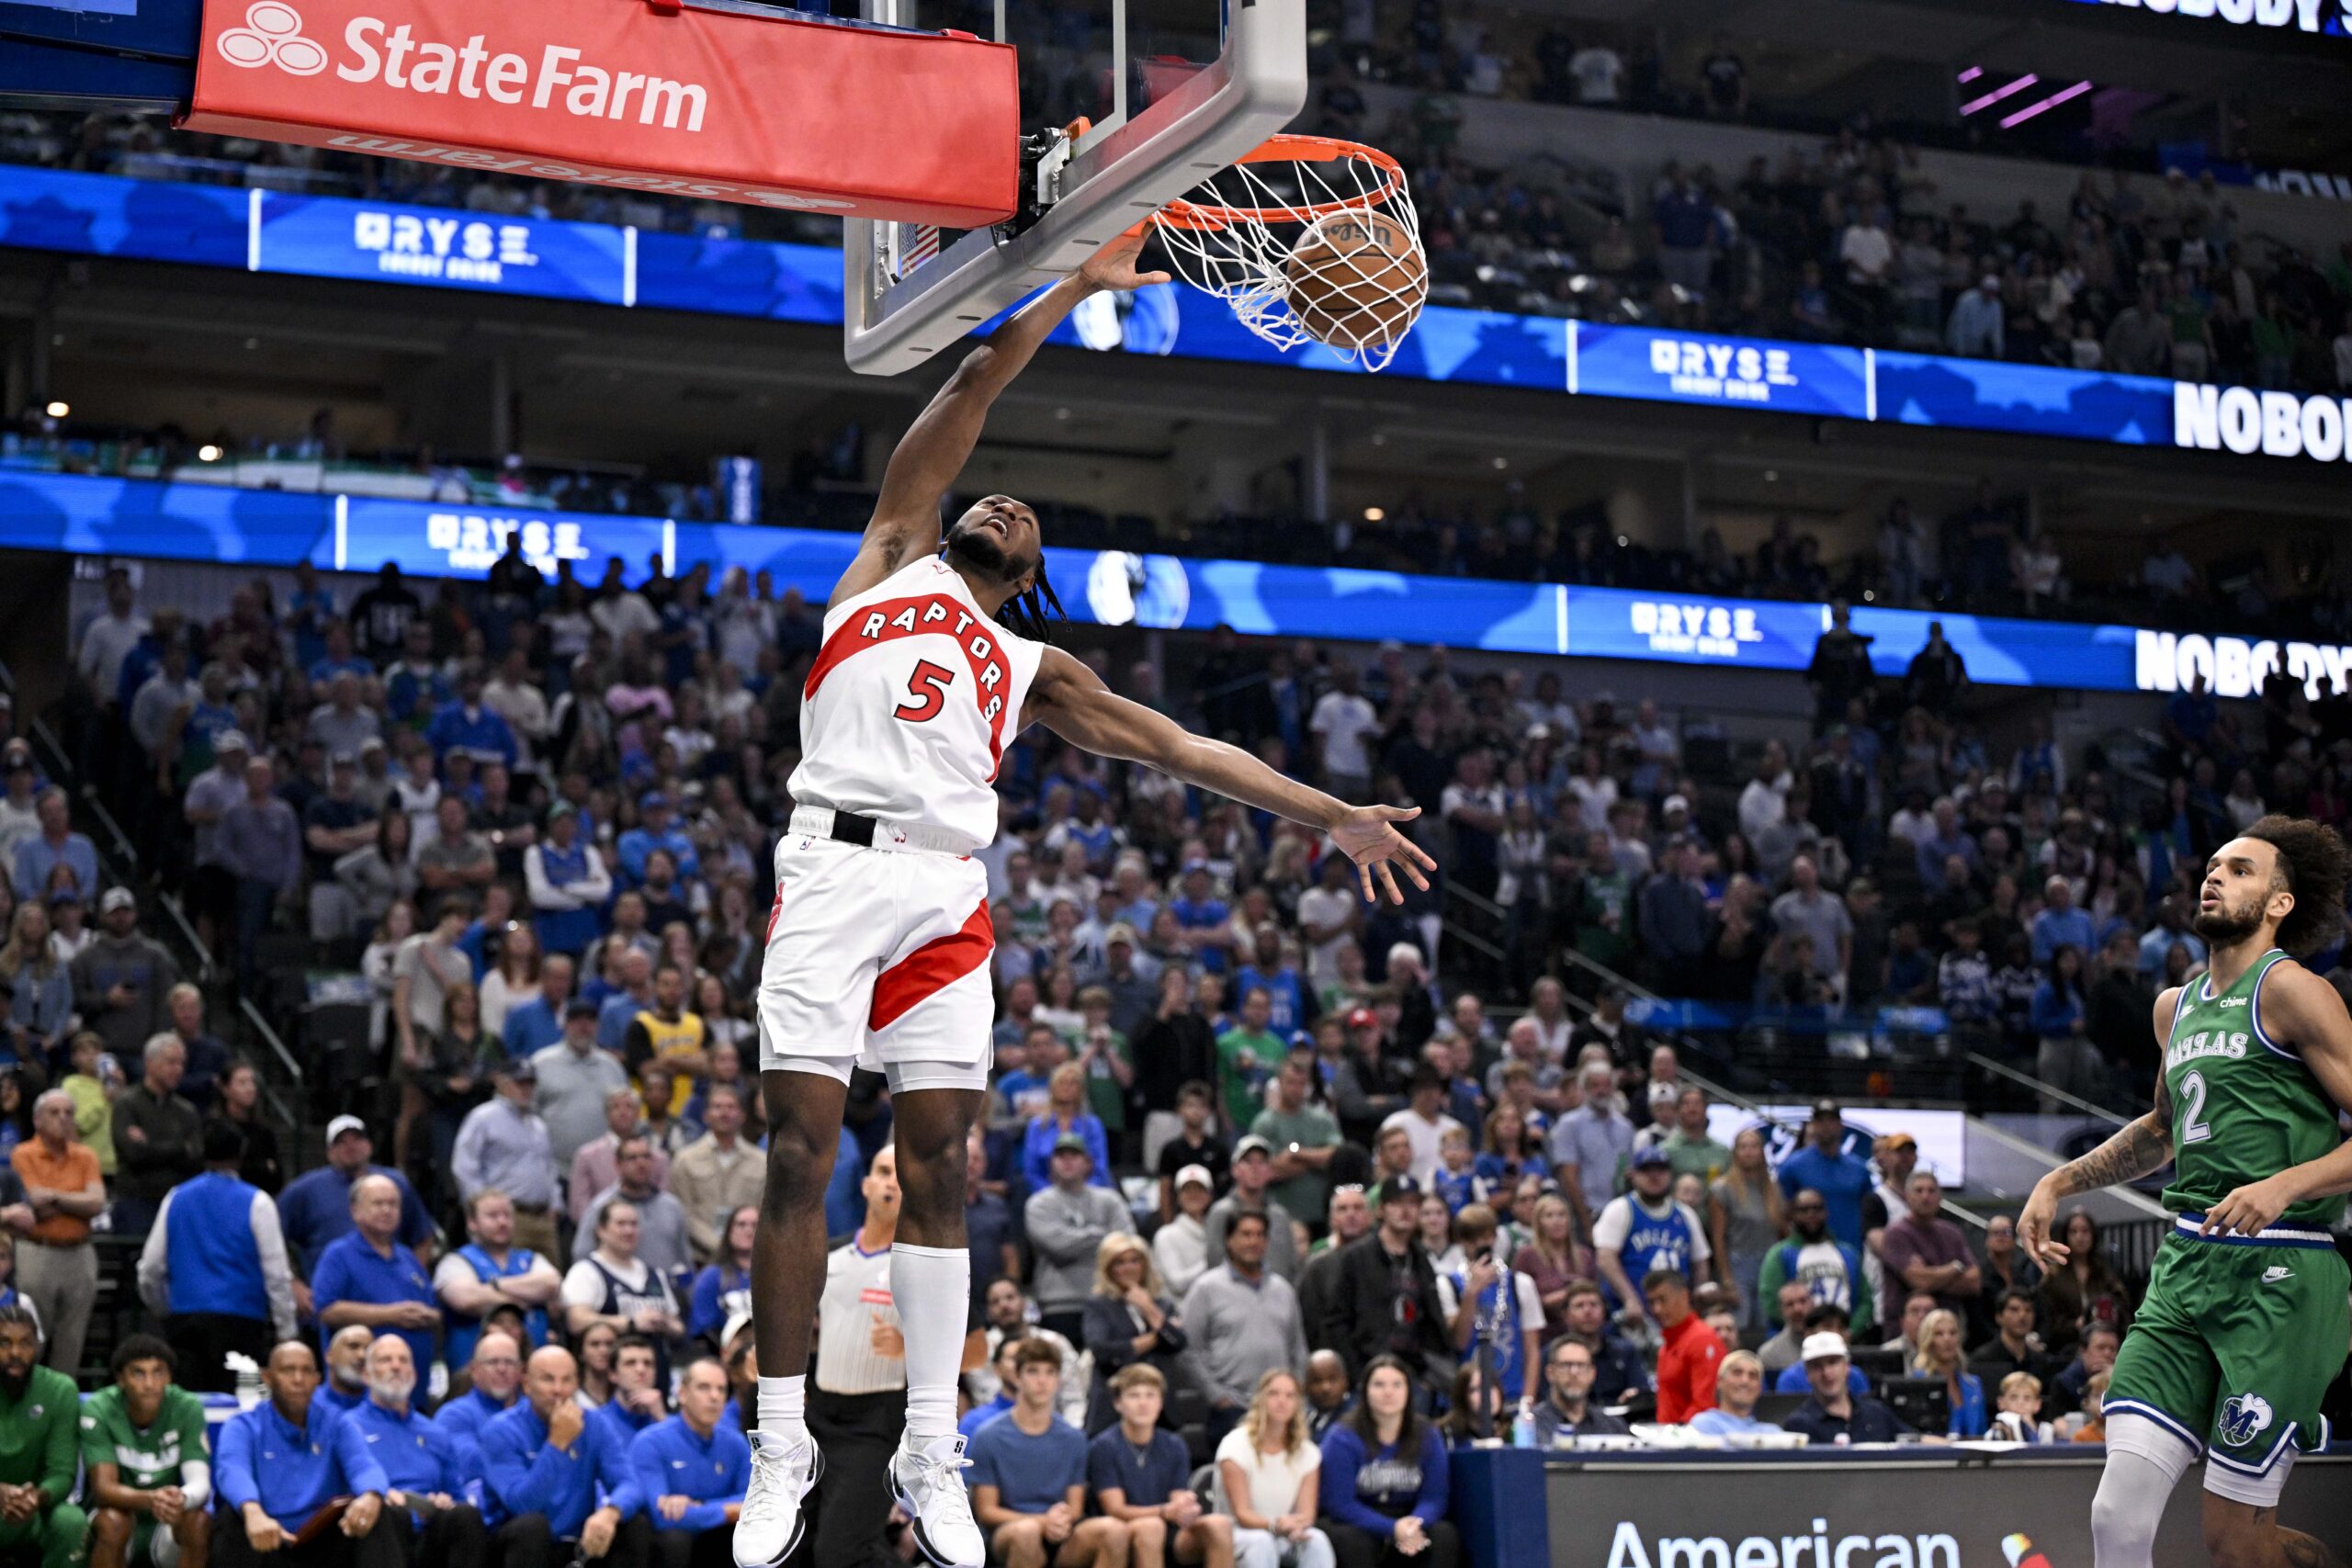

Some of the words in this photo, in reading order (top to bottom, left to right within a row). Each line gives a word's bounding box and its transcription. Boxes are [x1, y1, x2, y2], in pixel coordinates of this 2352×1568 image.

[2174, 380, 2352, 463] NOBO
[860, 600, 1002, 723] RAPTORS
[893, 659, 956, 723] 5
[2220, 997, 2248, 1009] chime
[2179, 1069, 2211, 1145] 2
[2265, 1265, 2290, 1277] NIKE
[1604, 1517, 1961, 1568] American
